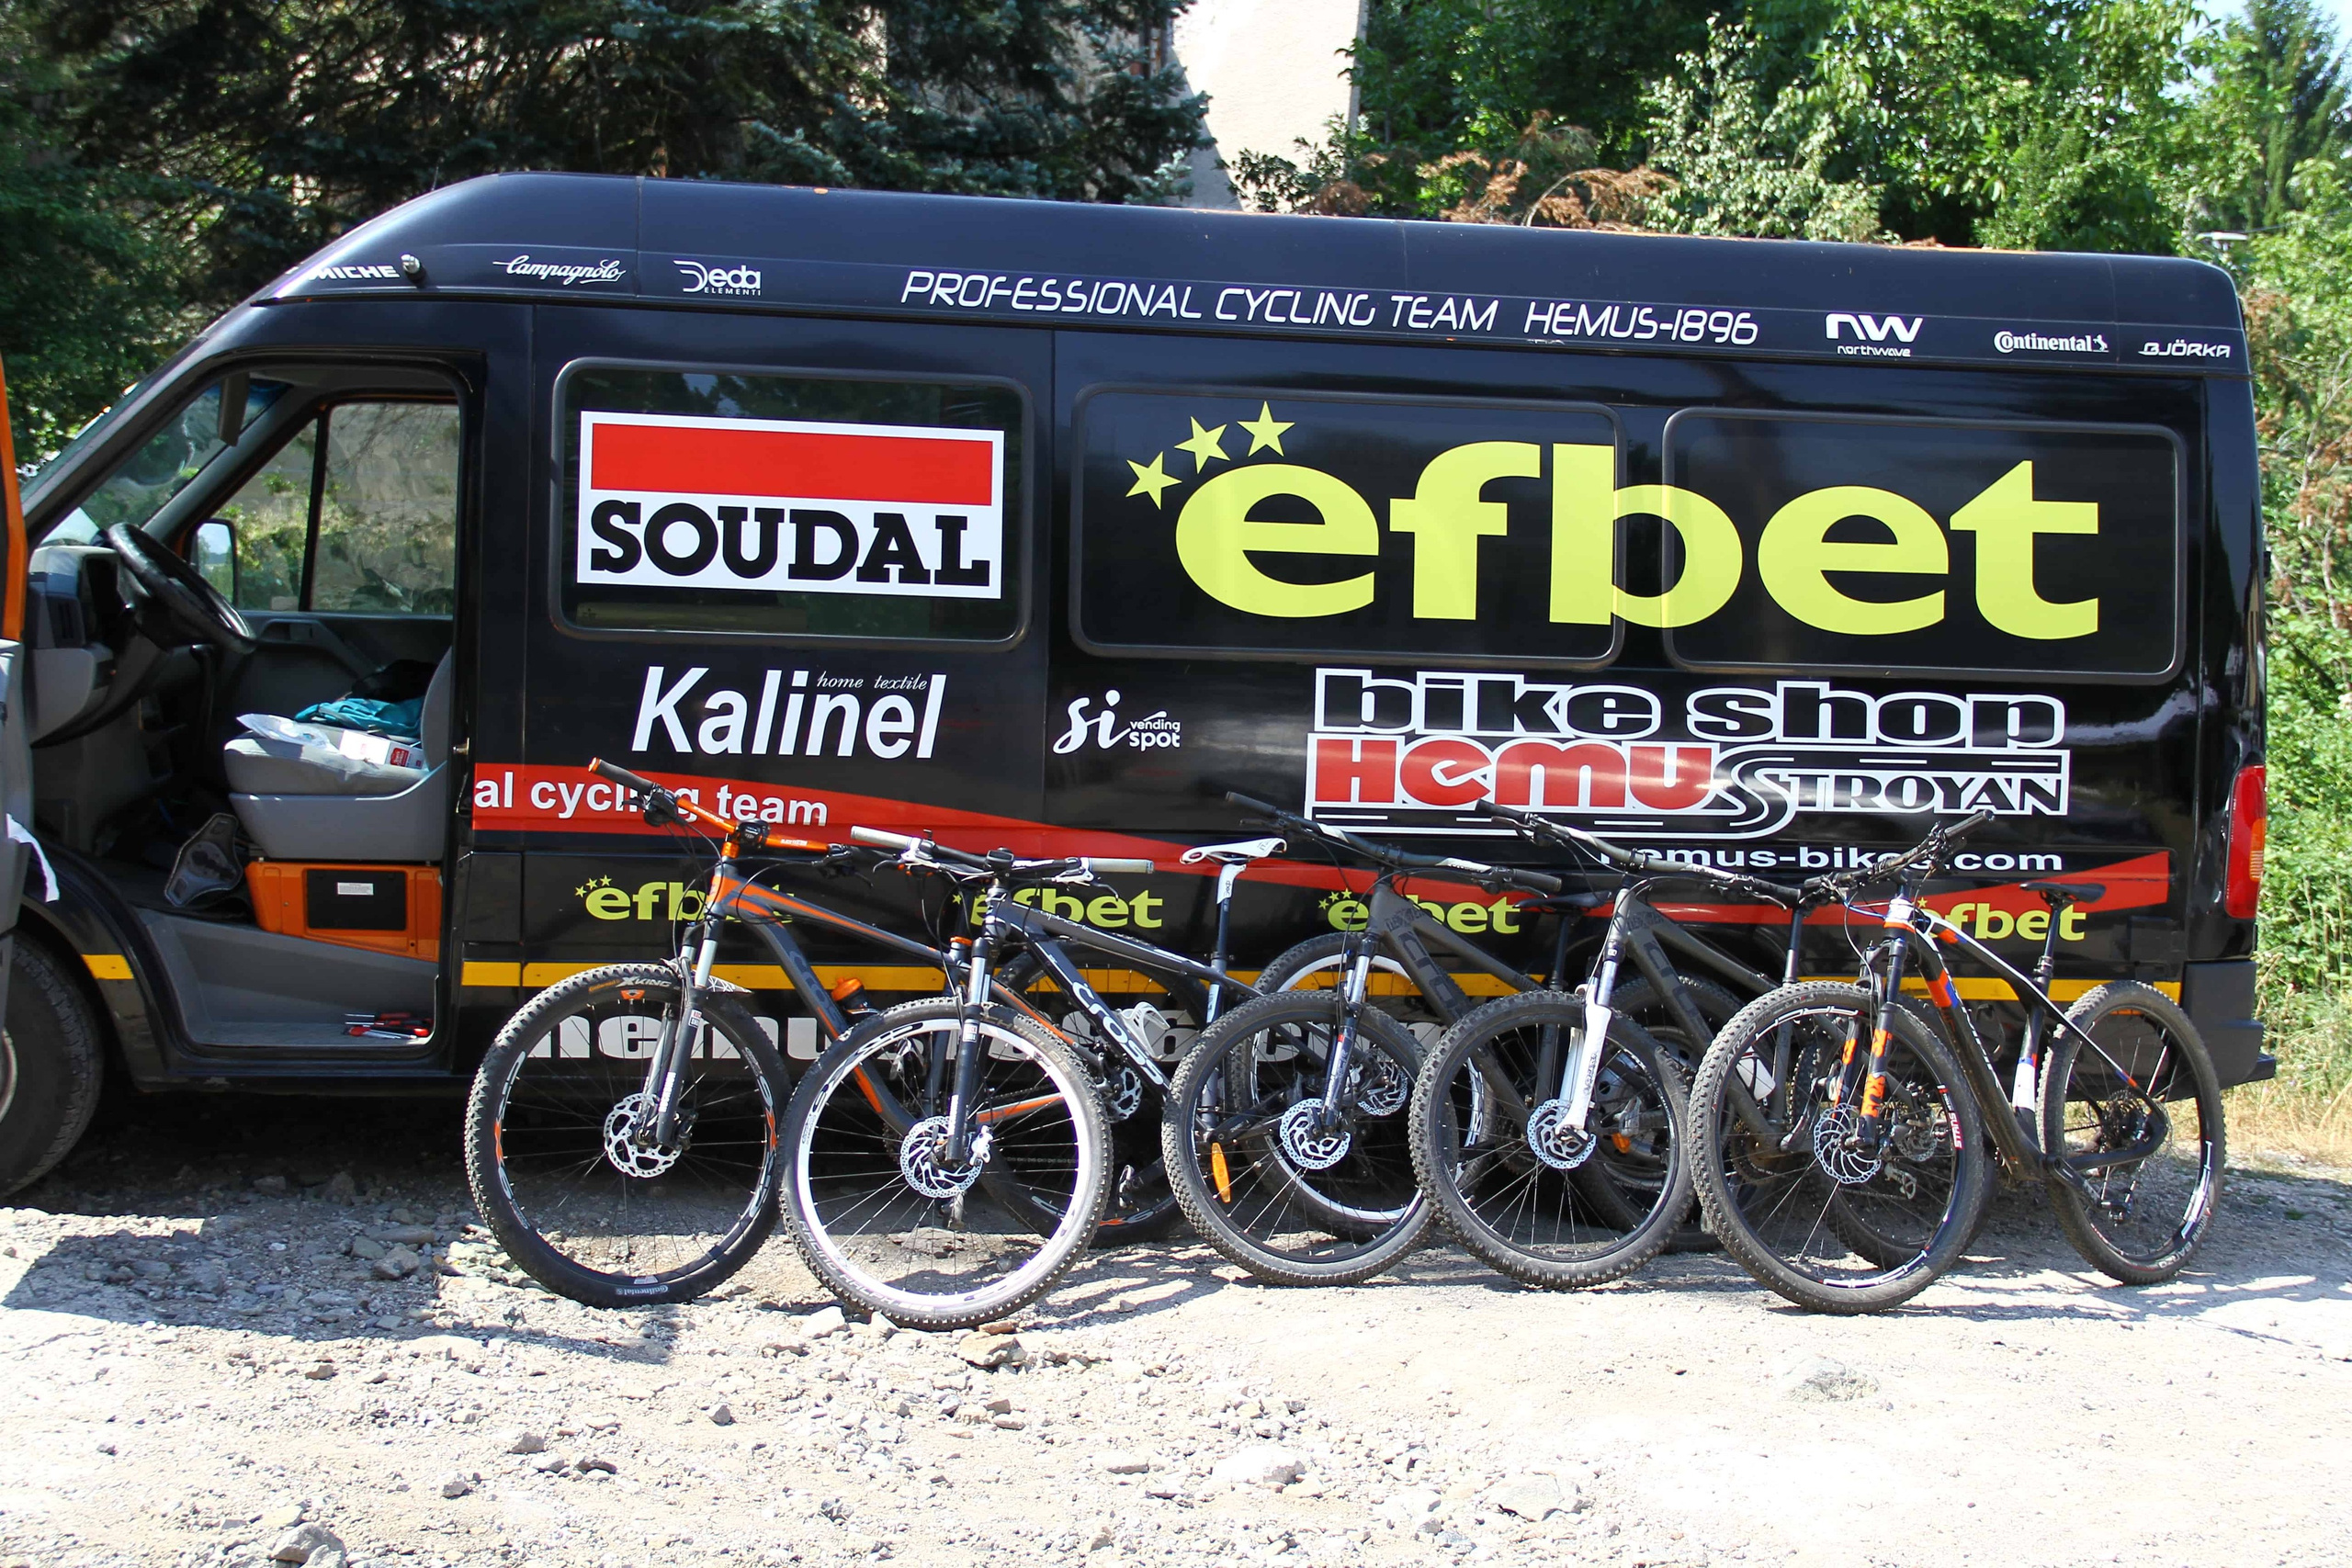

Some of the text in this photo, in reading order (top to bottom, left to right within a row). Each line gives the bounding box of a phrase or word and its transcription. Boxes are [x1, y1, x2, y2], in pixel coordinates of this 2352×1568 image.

[310, 265, 401, 280] MICHE
[492, 254, 627, 286] Campagnolo
[704, 286, 762, 297] ELEMENTI
[900, 270, 1759, 346] PROFESSIONAL CYCLING TEAM HEMUS-1896
[1837, 344, 1912, 358] northwave
[1993, 330, 2093, 354] Continental
[590, 499, 990, 588] SOUDAL
[1174, 440, 2100, 641] efbet
[816, 670, 929, 691] home textile
[631, 665, 947, 759] Kalinel
[1313, 667, 2066, 750] bike shop
[1129, 718, 1182, 733] vending
[1128, 731, 1182, 752] spot
[717, 784, 829, 827] team
